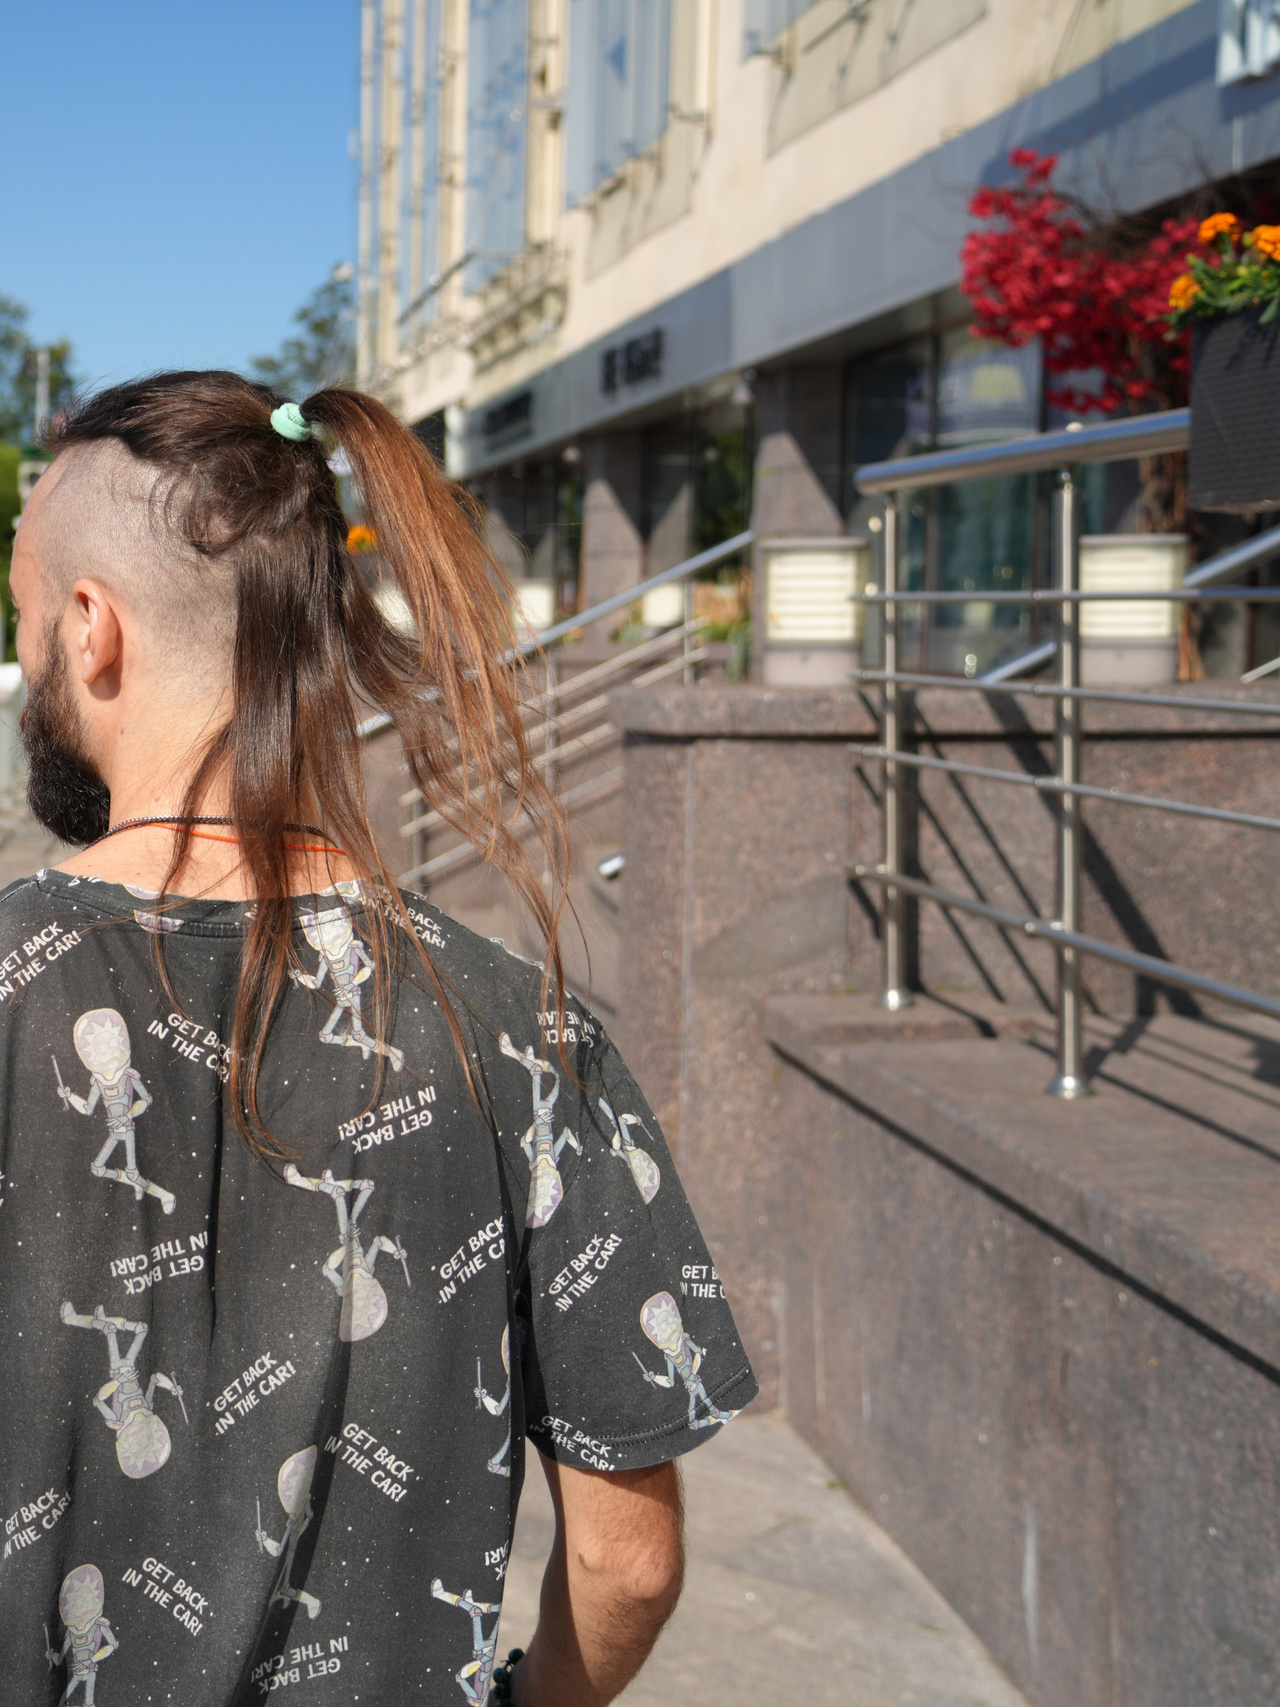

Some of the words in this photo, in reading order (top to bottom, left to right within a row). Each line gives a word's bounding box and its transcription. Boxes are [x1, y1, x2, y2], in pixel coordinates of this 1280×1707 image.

[407, 907, 442, 935] BACK
[22, 921, 64, 957] BACK
[13, 957, 46, 986] THE
[46, 930, 82, 961] CAR!
[147, 1019, 169, 1040] IN
[171, 1034, 205, 1062] THE
[167, 1013, 204, 1039] GET
[379, 1095, 416, 1121] THE
[417, 1085, 436, 1106] IN
[338, 1111, 376, 1140] CAR!
[400, 1109, 433, 1136] GET
[351, 1124, 394, 1154] BACK
[150, 1239, 186, 1263] THE
[189, 1230, 208, 1251] IN
[440, 1245, 466, 1279] GET
[468, 1215, 504, 1253] BACK
[109, 1254, 148, 1277] CAR!
[169, 1254, 205, 1277] GET
[439, 1280, 457, 1303] IN
[456, 1253, 487, 1283] THE
[548, 1266, 573, 1295] GET
[570, 1233, 604, 1273] BACK
[554, 1293, 573, 1312] IN
[568, 1271, 599, 1298] THE
[594, 1233, 622, 1270] CAR!
[682, 1264, 709, 1279] GET
[123, 1265, 162, 1295] BACK
[690, 1283, 717, 1298] THE
[213, 1378, 243, 1412] GET
[242, 1351, 277, 1388] BACK
[215, 1411, 235, 1434] IN
[234, 1389, 260, 1416] THE
[259, 1360, 296, 1395] CAR!
[541, 1415, 573, 1433] GET
[572, 1430, 612, 1458] BACK
[550, 1430, 577, 1453] THE
[343, 1423, 378, 1450] GET
[373, 1445, 414, 1482] BACK
[324, 1435, 343, 1454] IN
[341, 1445, 374, 1475] THE
[370, 1470, 408, 1502] CAR!
[5, 1511, 20, 1535] GET
[20, 1487, 60, 1523] BACK
[11, 1525, 42, 1550] THE
[42, 1491, 72, 1529] CAR!
[142, 1557, 176, 1584] GET
[172, 1578, 209, 1615] BACK
[121, 1567, 143, 1587] IN
[143, 1579, 174, 1609] THE
[173, 1603, 203, 1636] CAR!
[289, 1642, 325, 1664] THE
[329, 1635, 349, 1654] IN
[251, 1655, 285, 1683] CAR!
[258, 1667, 300, 1694] BACK
[306, 1657, 341, 1680] GET
